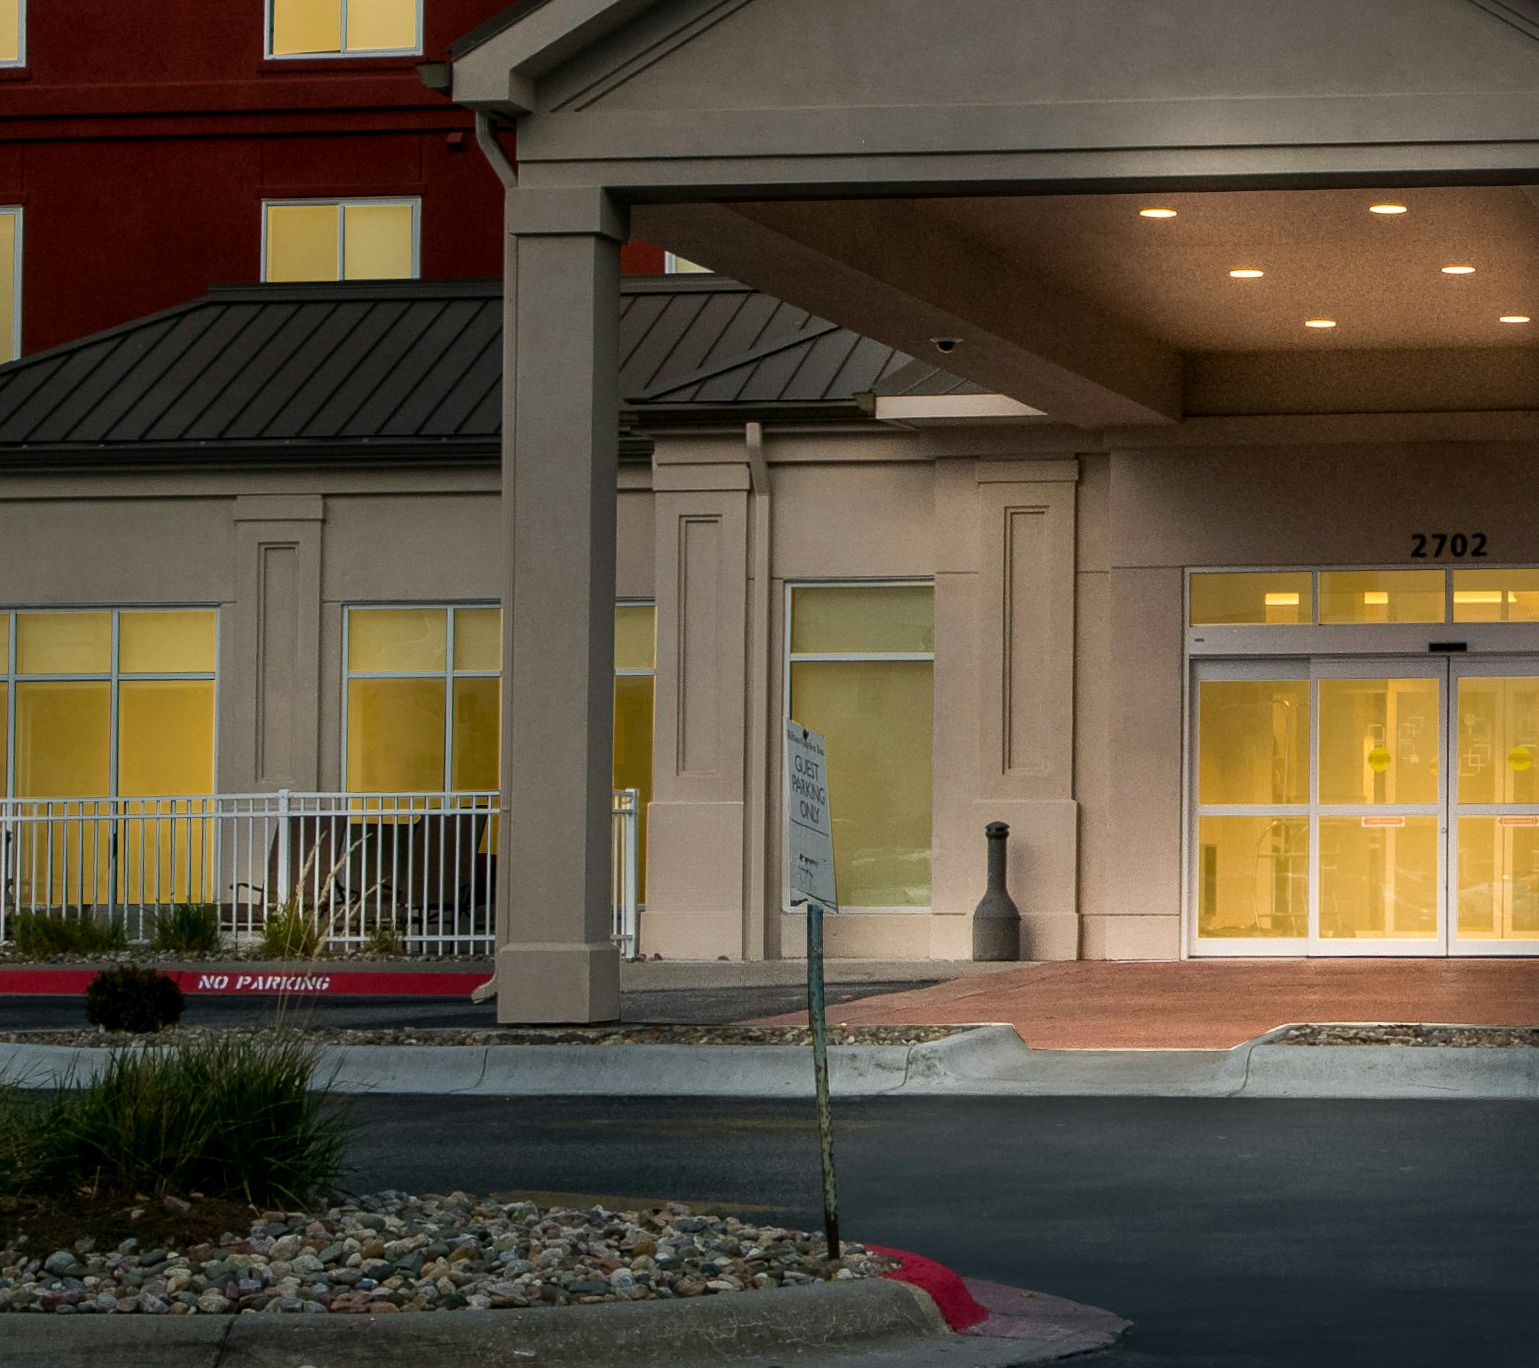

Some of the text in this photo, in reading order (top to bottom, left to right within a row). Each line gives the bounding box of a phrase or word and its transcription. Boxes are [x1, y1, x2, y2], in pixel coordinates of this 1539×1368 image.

[1411, 532, 1487, 558] 2702
[794, 754, 819, 781] GUEST
[792, 775, 825, 805] PARKING
[801, 801, 819, 823] ONLY
[198, 975, 330, 990] NO PARKING
